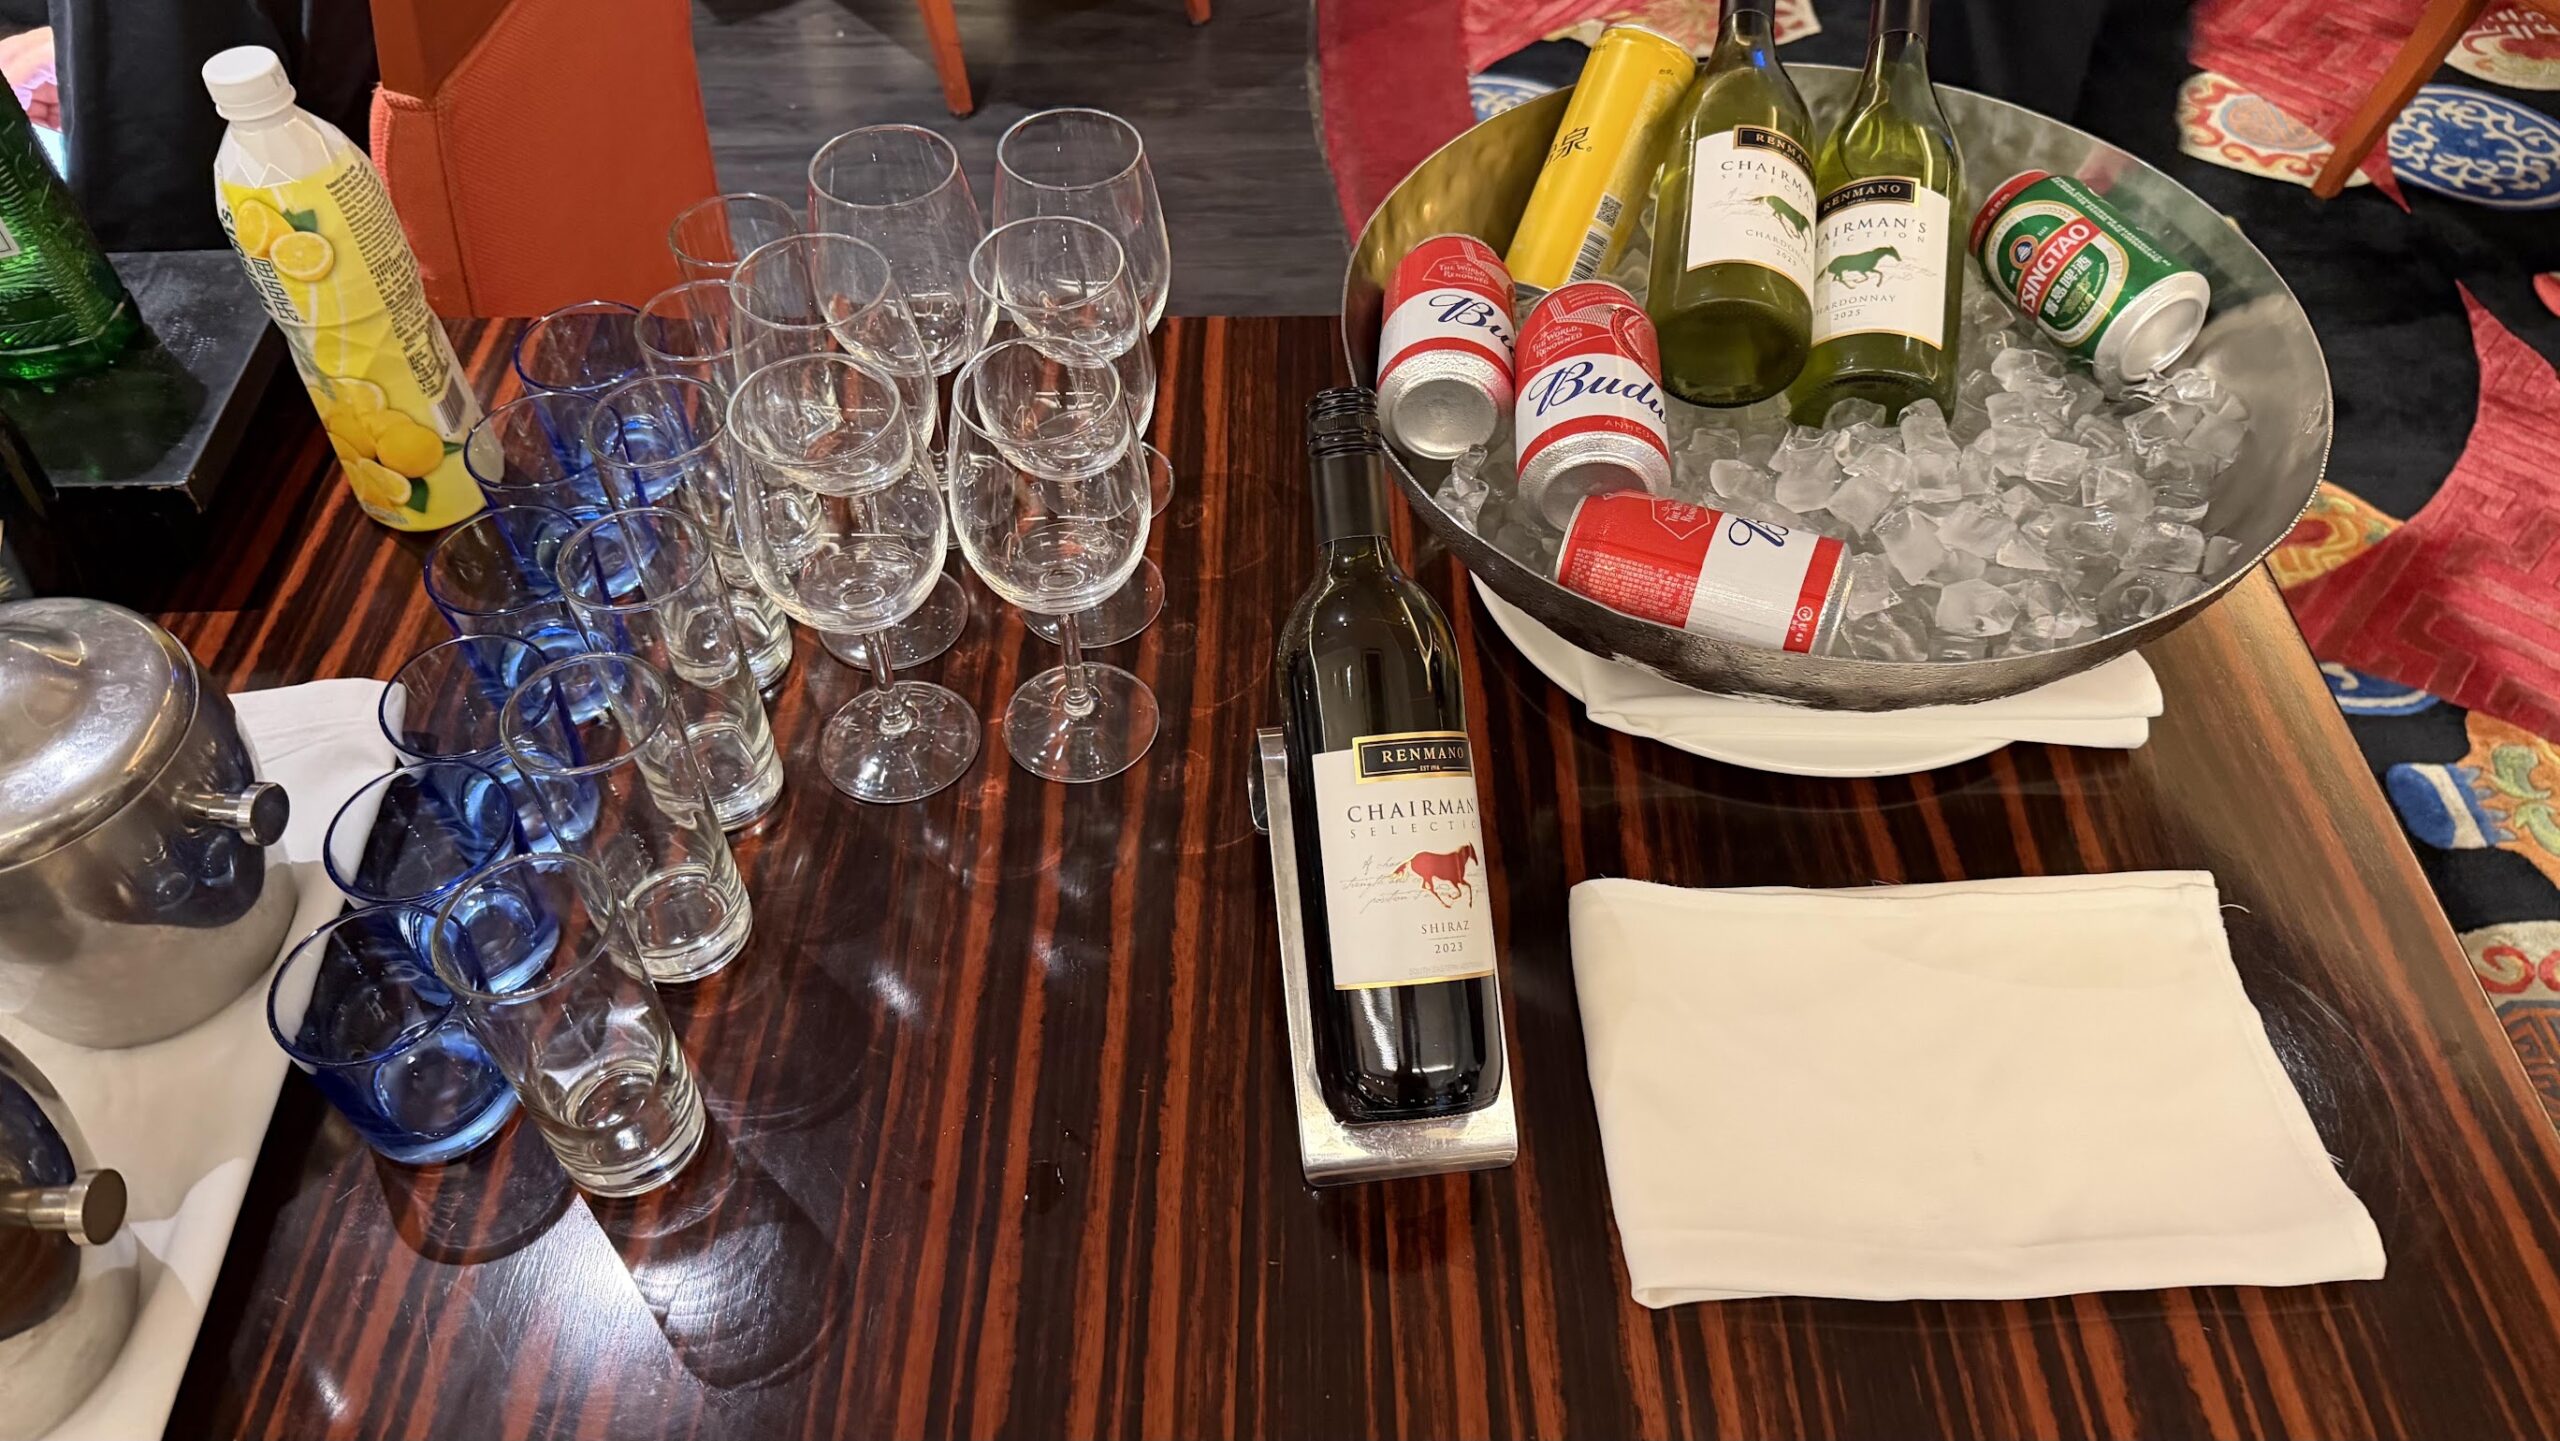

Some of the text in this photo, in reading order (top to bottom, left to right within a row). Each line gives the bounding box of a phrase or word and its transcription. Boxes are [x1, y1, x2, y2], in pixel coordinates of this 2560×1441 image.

[1823, 183, 1902, 212] RENMANO
[1816, 217, 1928, 249] AIRMAN'S
[2020, 223, 2090, 314] TSINGTAO
[1381, 746, 1464, 764] RENMANO
[1347, 798, 1475, 823] CHAIRMAN
[1421, 920, 1470, 935] SHIRAZ
[1434, 941, 1464, 955] 2023
